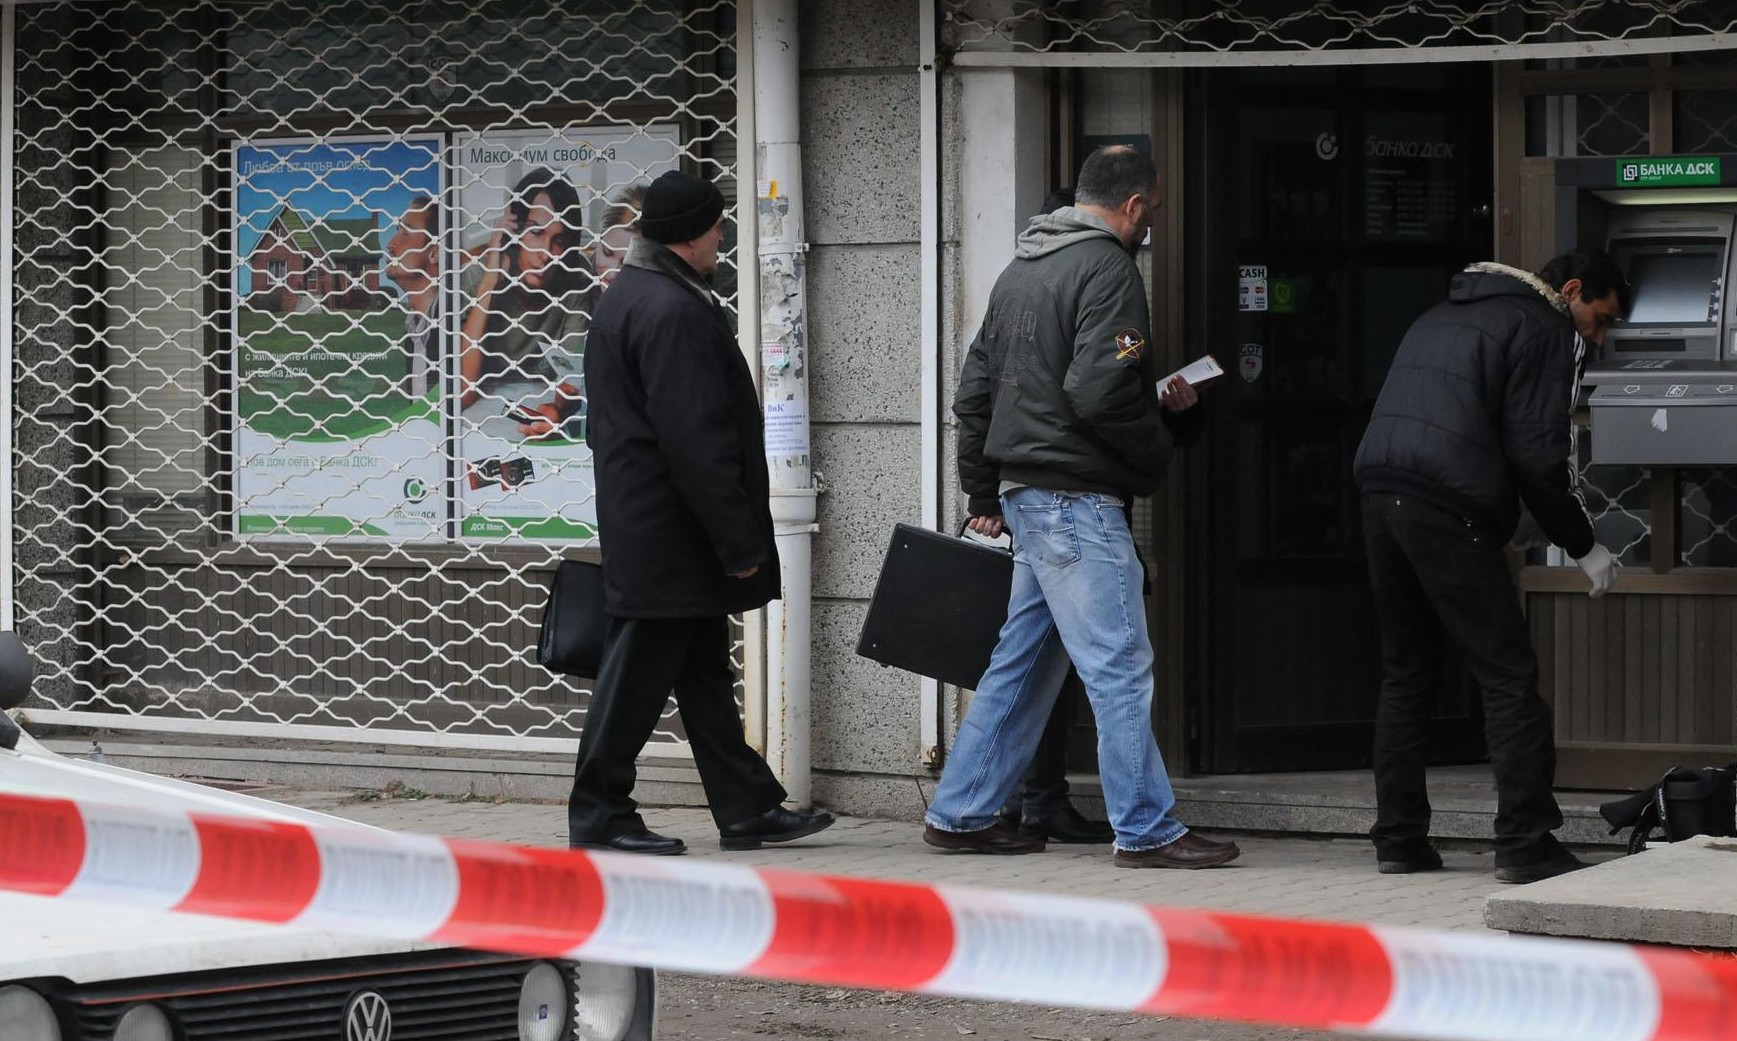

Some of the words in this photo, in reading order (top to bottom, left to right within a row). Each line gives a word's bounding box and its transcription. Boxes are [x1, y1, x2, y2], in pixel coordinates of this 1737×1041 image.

[1640, 163, 1684, 176] БАНКА
[1685, 162, 1715, 175] ДСК
[1239, 268, 1266, 279] CASH
[266, 458, 286, 469] дом
